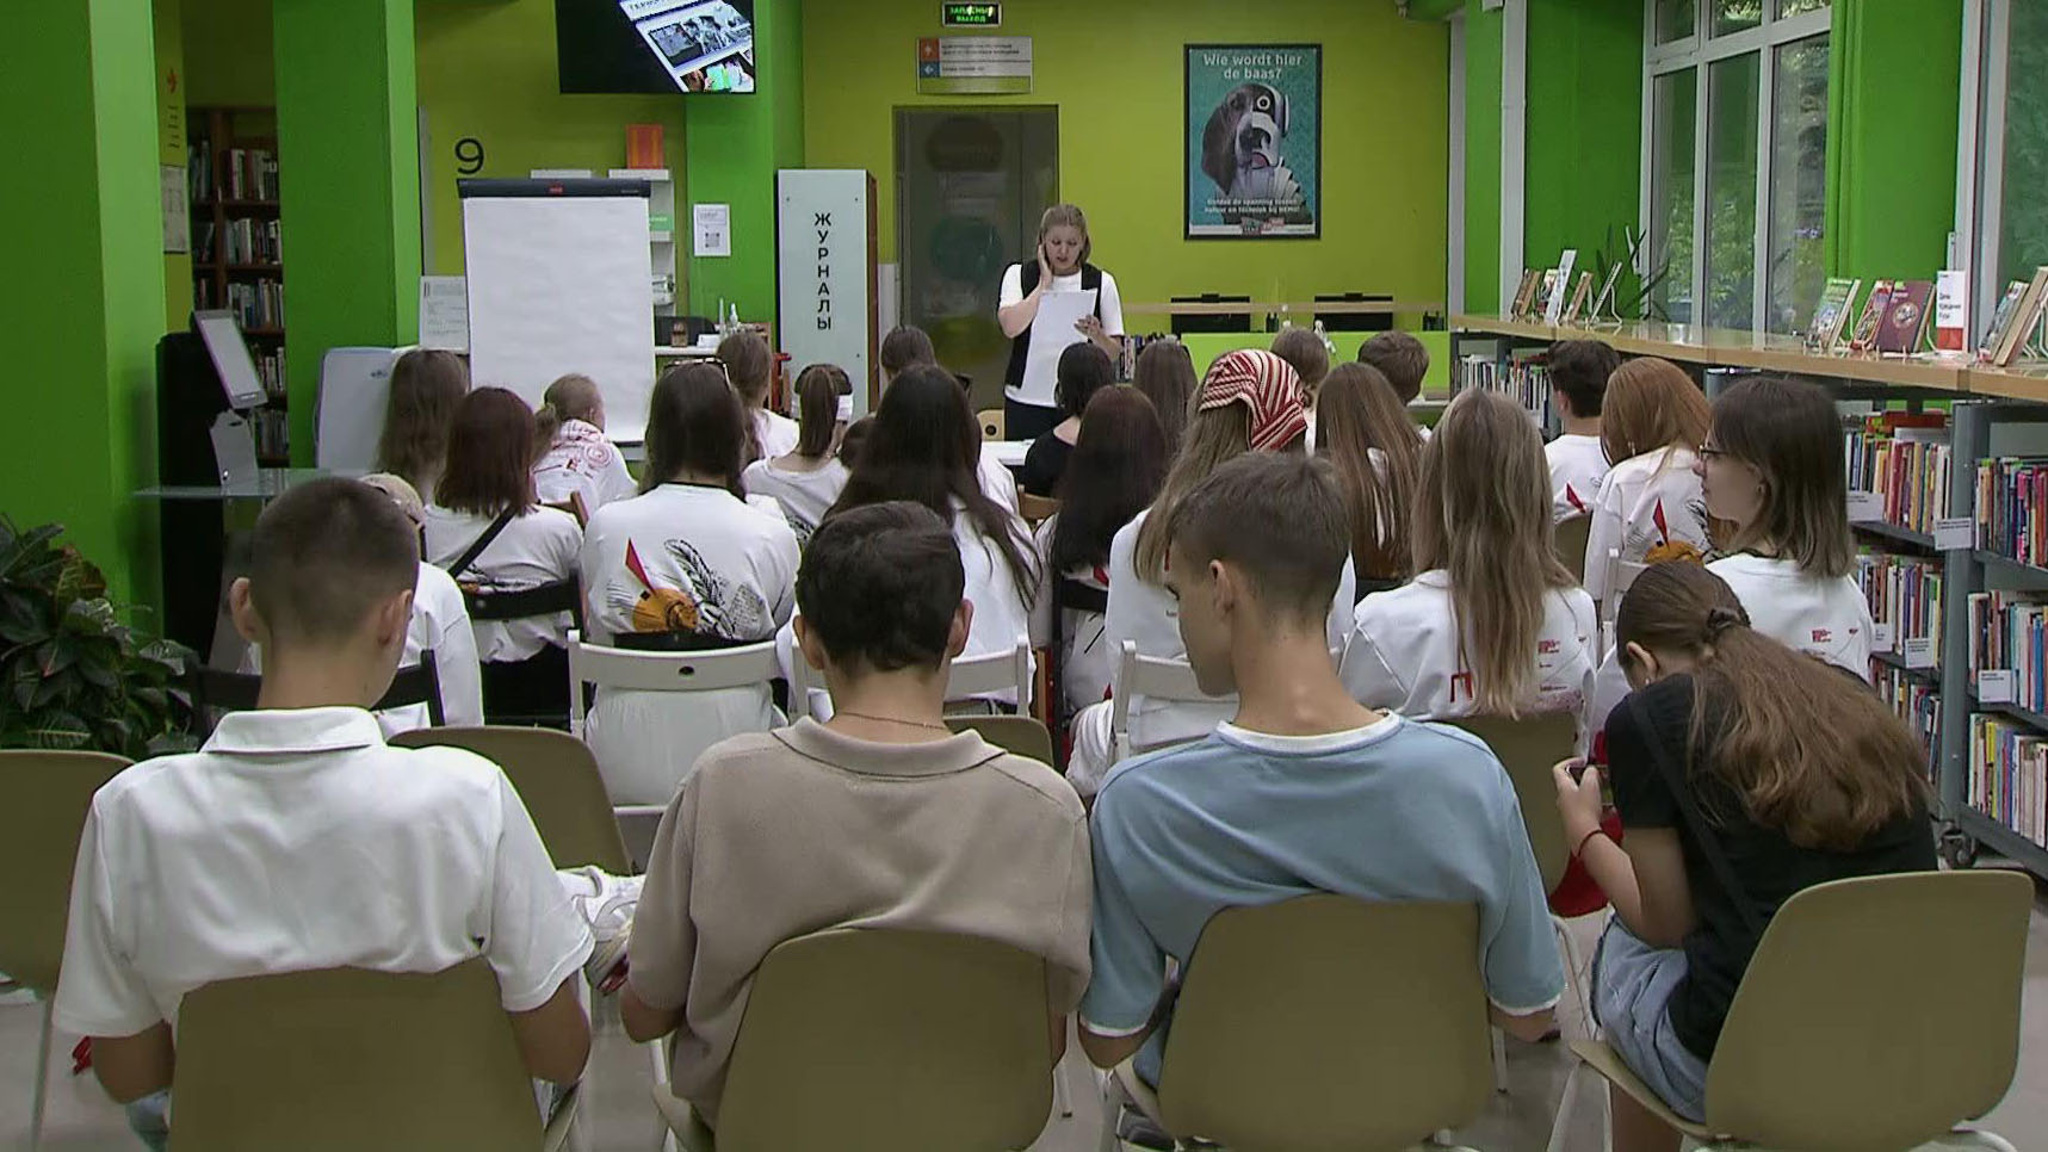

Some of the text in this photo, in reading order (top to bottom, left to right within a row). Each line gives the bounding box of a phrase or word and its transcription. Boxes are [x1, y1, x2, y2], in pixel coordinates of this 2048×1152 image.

[1203, 53, 1302, 66] Wie wordt hier
[1223, 67, 1282, 79] de baas?
[455, 138, 484, 174] 9
[815, 213, 831, 330] ЖУРНАЛЫ
